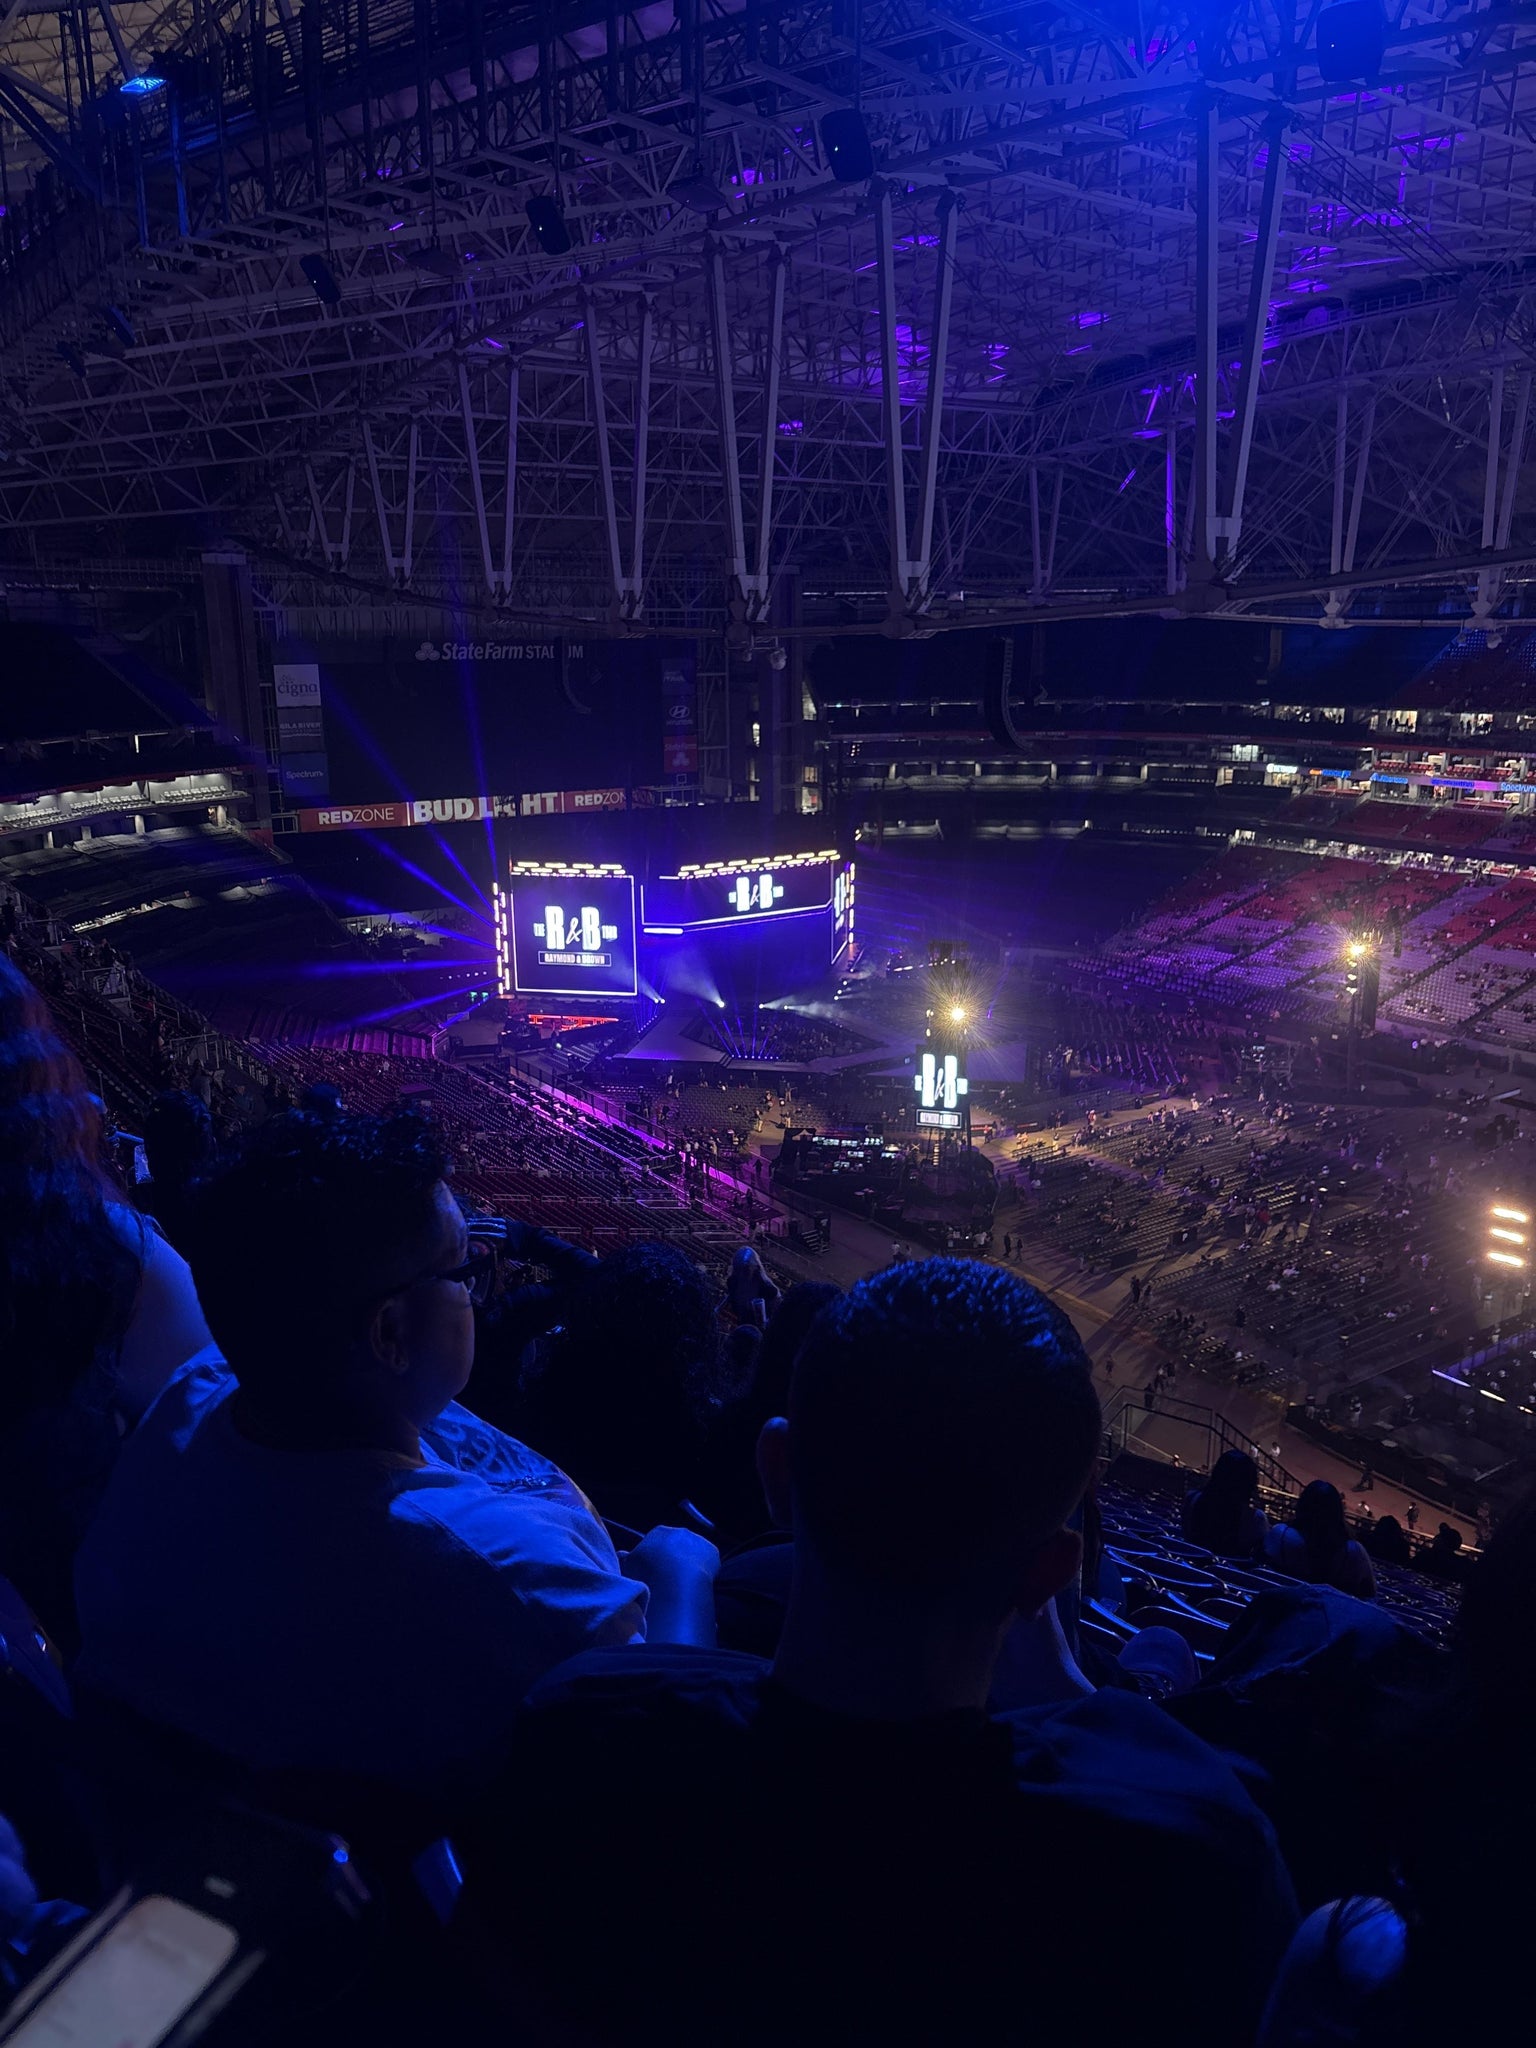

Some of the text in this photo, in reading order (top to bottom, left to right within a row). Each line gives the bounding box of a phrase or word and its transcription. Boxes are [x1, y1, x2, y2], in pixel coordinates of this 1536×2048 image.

[525, 645, 584, 660] STAUM
[277, 680, 318, 697] cigna
[285, 770, 321, 780] Spectrum
[1500, 782, 1536, 793] Spectrum
[574, 791, 627, 808] REDZON
[318, 807, 394, 825] REDZONE
[413, 798, 474, 824] BUD
